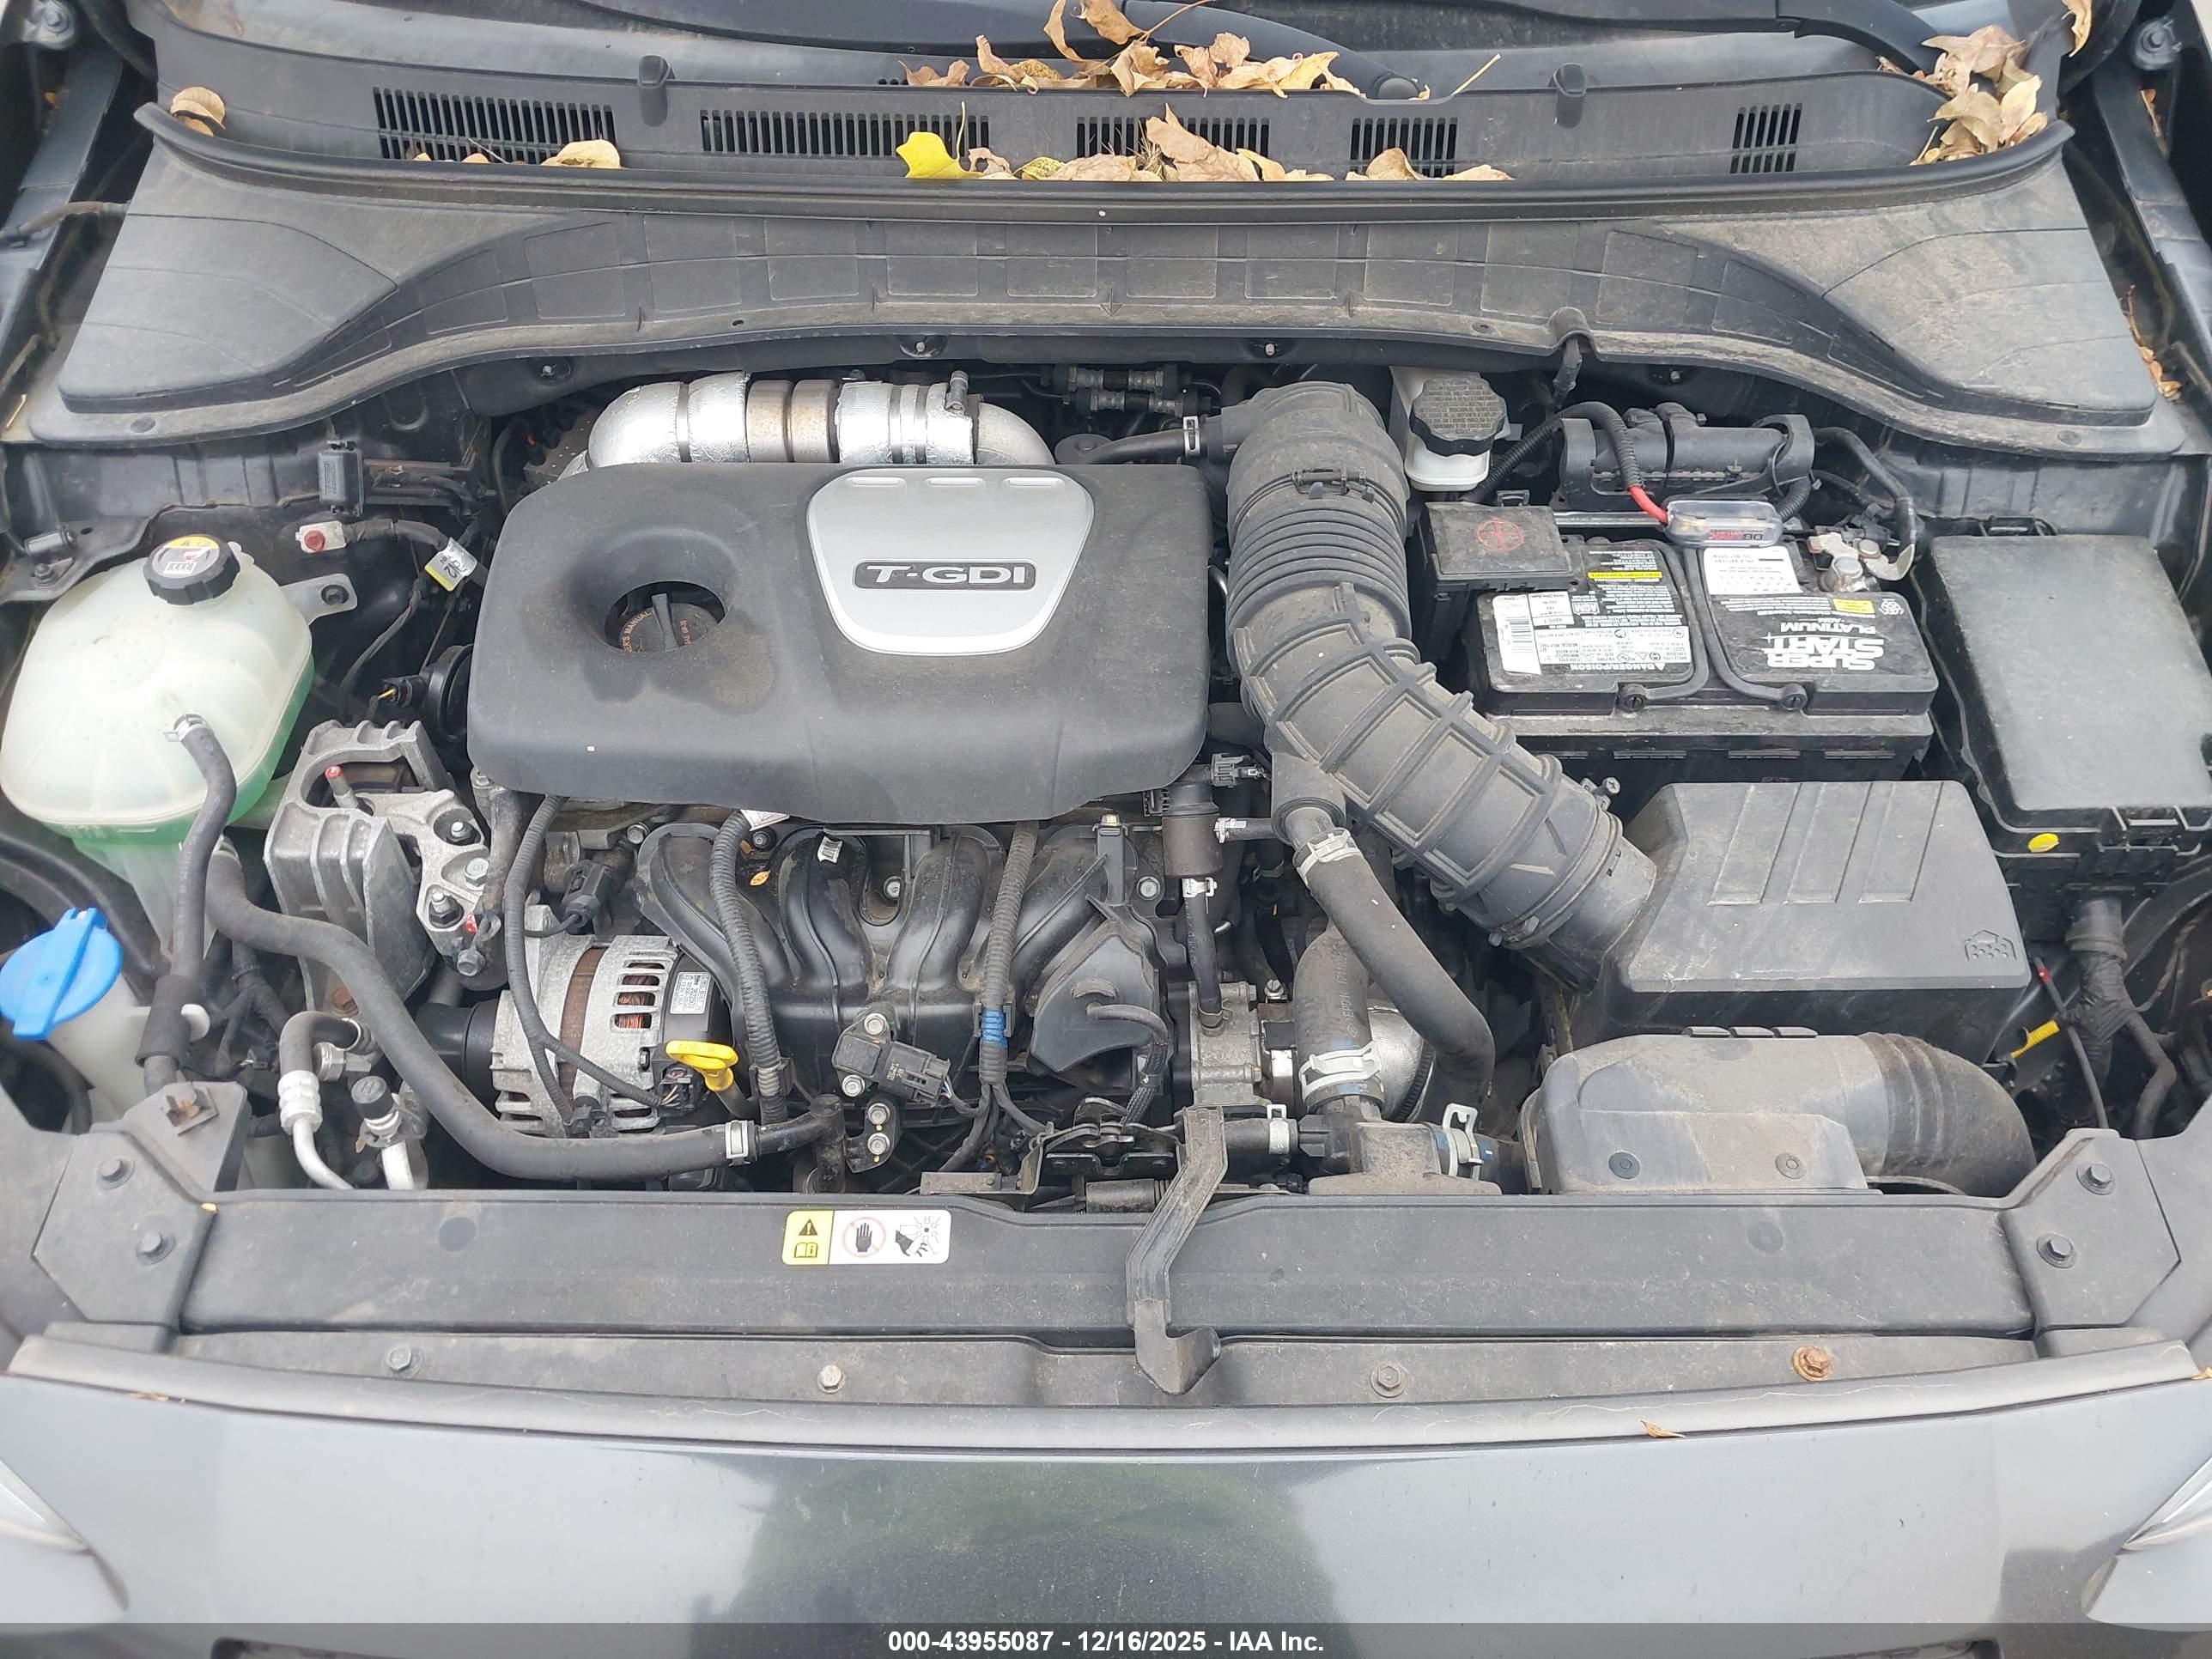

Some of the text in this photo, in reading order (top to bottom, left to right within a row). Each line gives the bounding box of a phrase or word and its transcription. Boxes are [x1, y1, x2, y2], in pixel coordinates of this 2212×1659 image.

[866, 566, 1025, 584] T-GDI
[1574, 604, 1597, 612] AGM
[1781, 622, 1875, 634] PLATINUM
[1759, 638, 1884, 659] START
[1767, 653, 1875, 670] SUPER
